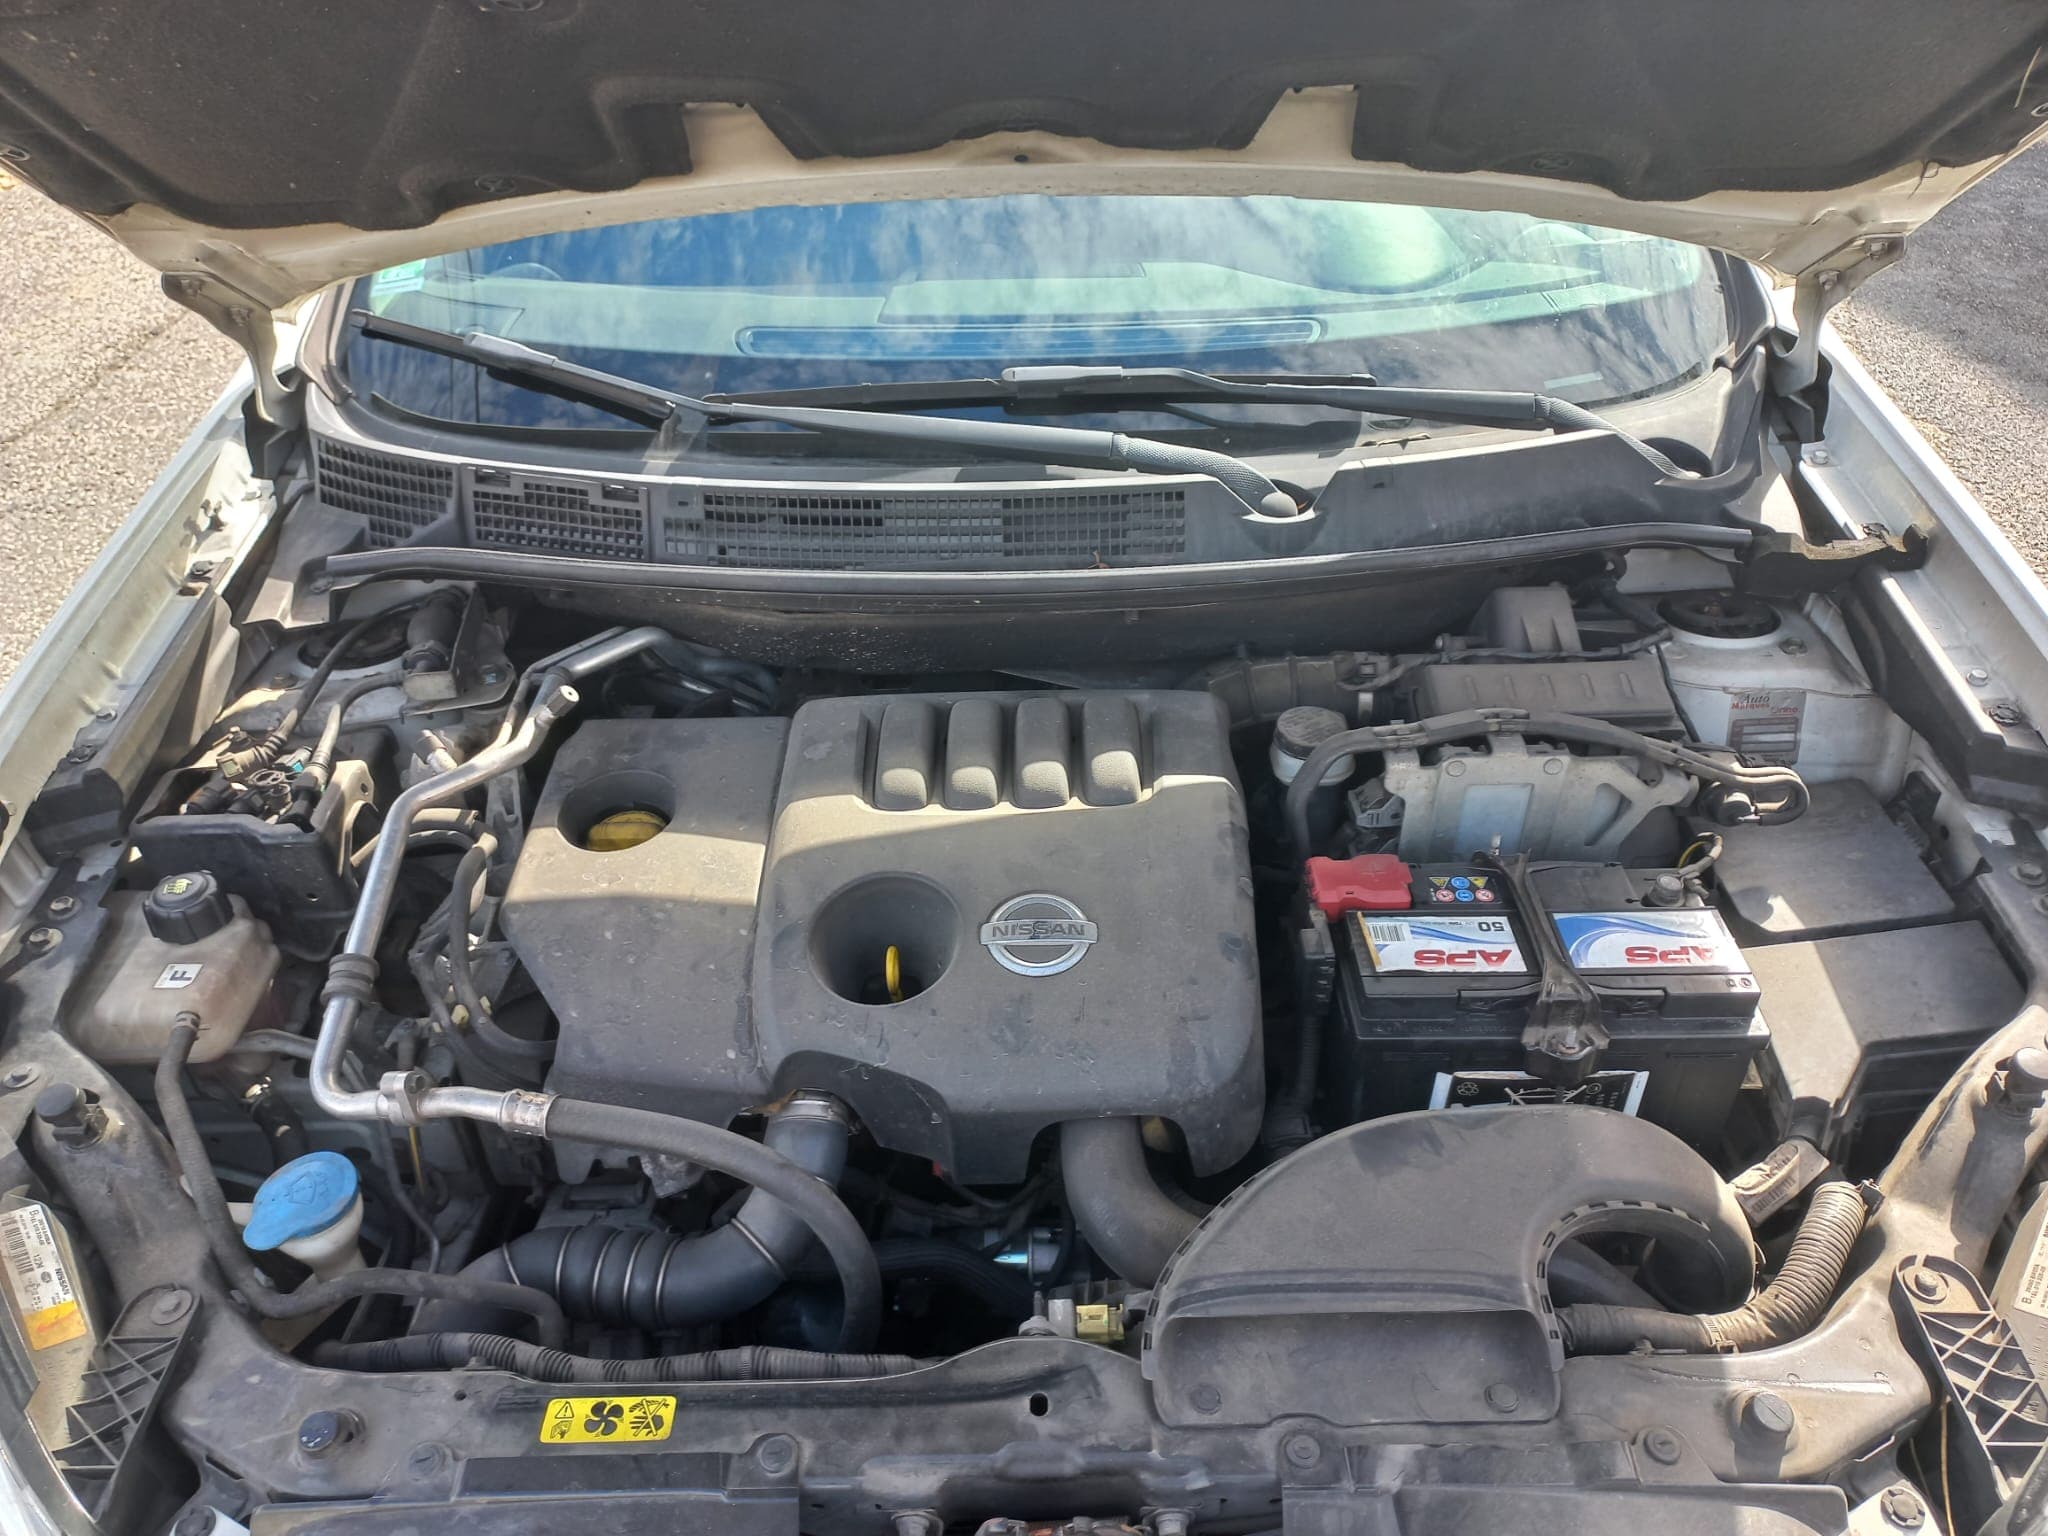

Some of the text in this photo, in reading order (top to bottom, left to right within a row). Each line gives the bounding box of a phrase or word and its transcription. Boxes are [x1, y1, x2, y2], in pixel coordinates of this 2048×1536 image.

[992, 923, 1085, 937] NISSAN
[1478, 921, 1505, 932] 50
[1414, 949, 1513, 967] APS
[1624, 945, 1715, 965] APS
[169, 970, 192, 981] F
[55, 1268, 70, 1296] NISSAN
